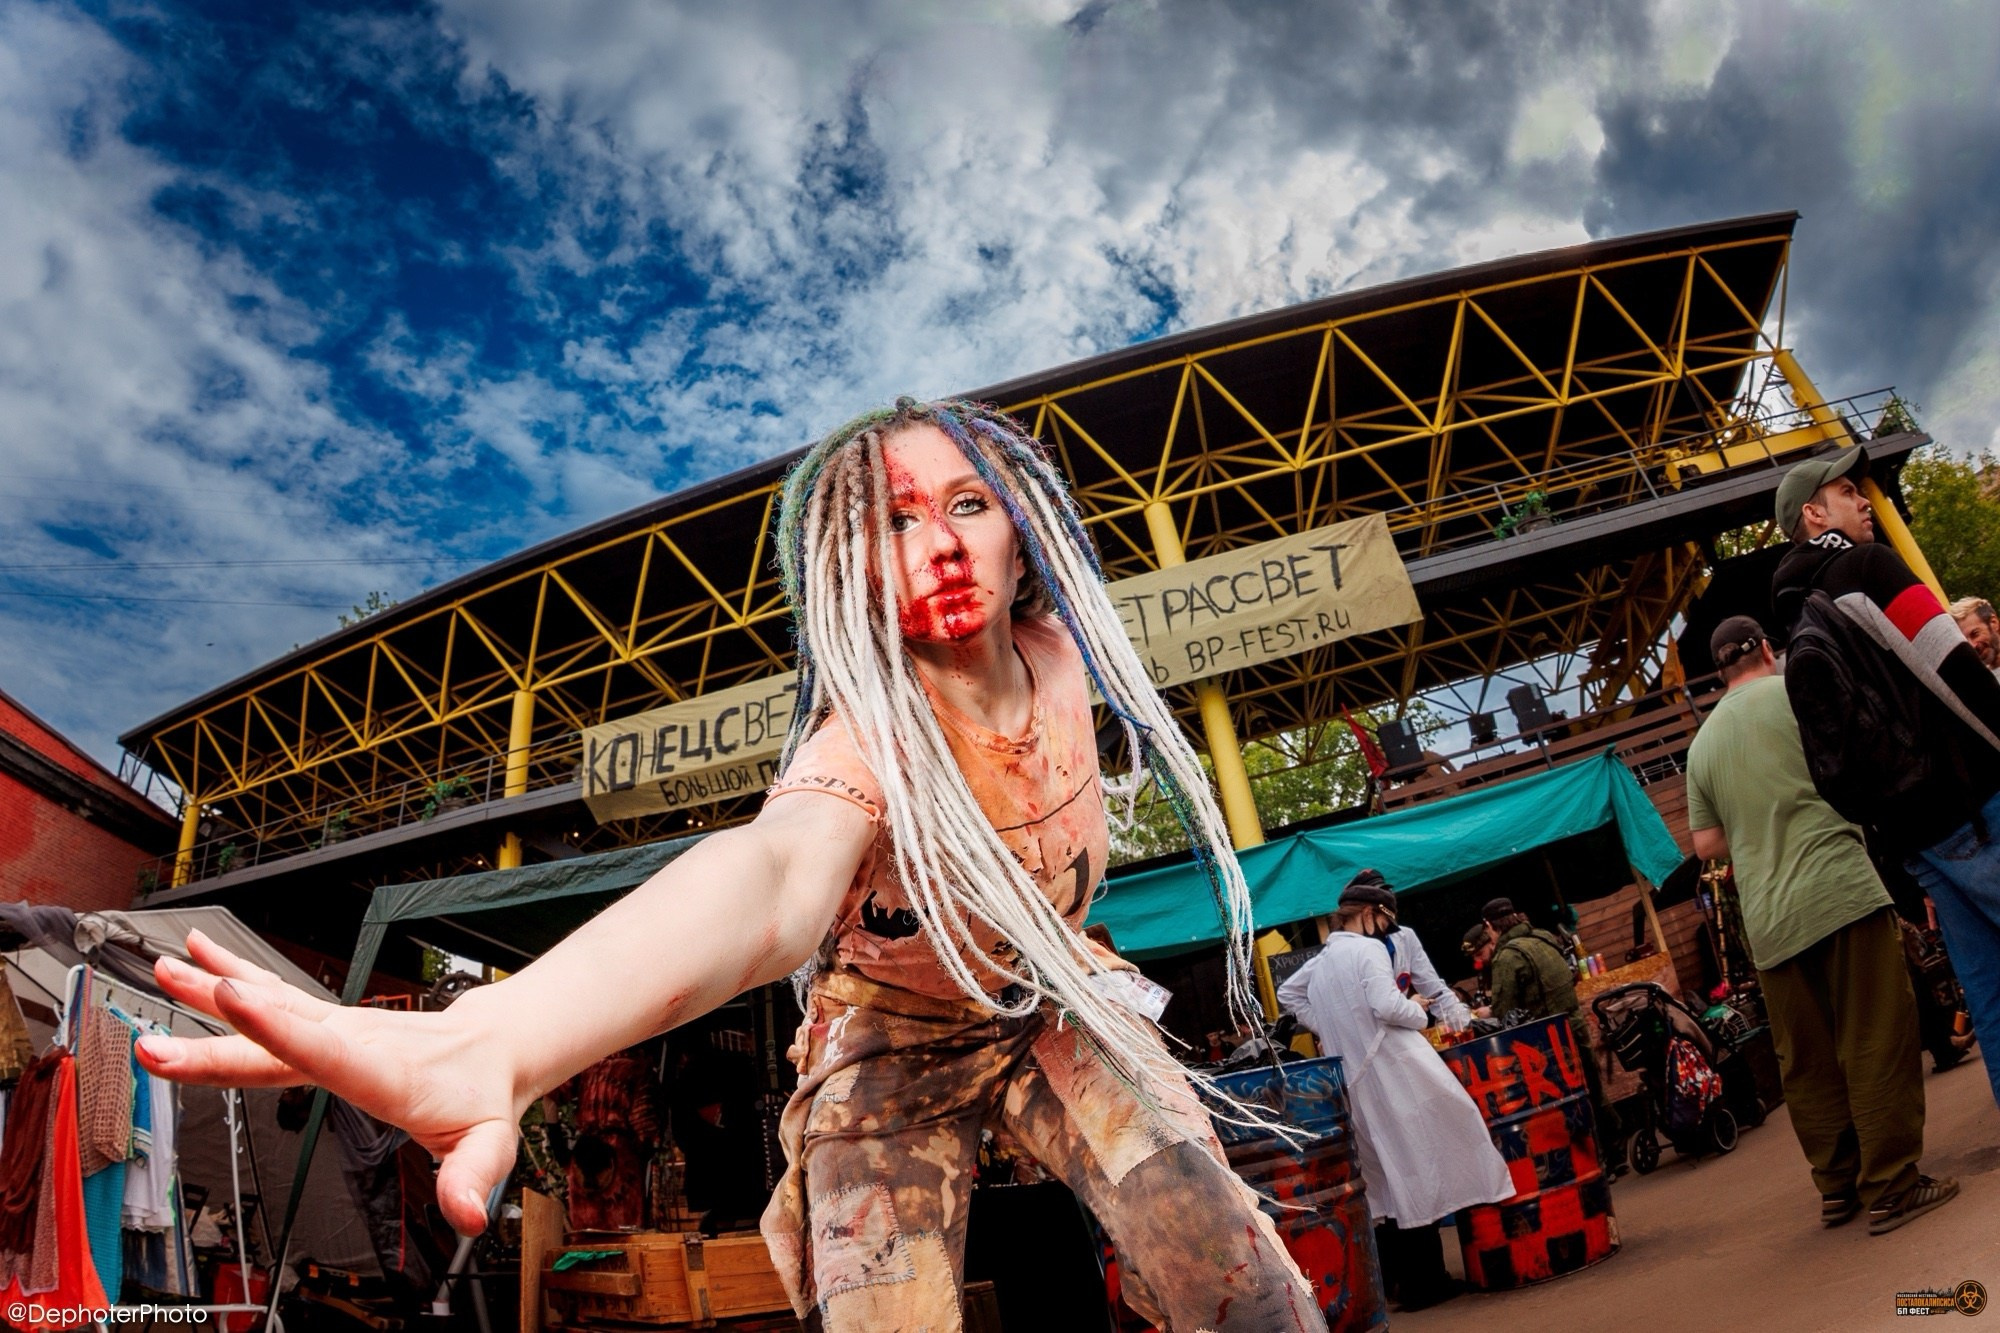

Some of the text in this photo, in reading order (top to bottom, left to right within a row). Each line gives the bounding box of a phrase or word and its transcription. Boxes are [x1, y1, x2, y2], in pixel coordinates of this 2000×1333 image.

[1161, 543, 1353, 635] РАССВЕТ
[1184, 608, 1351, 675] BP-FEST.RU
[658, 764, 753, 807] БОЛЬШОЙ
